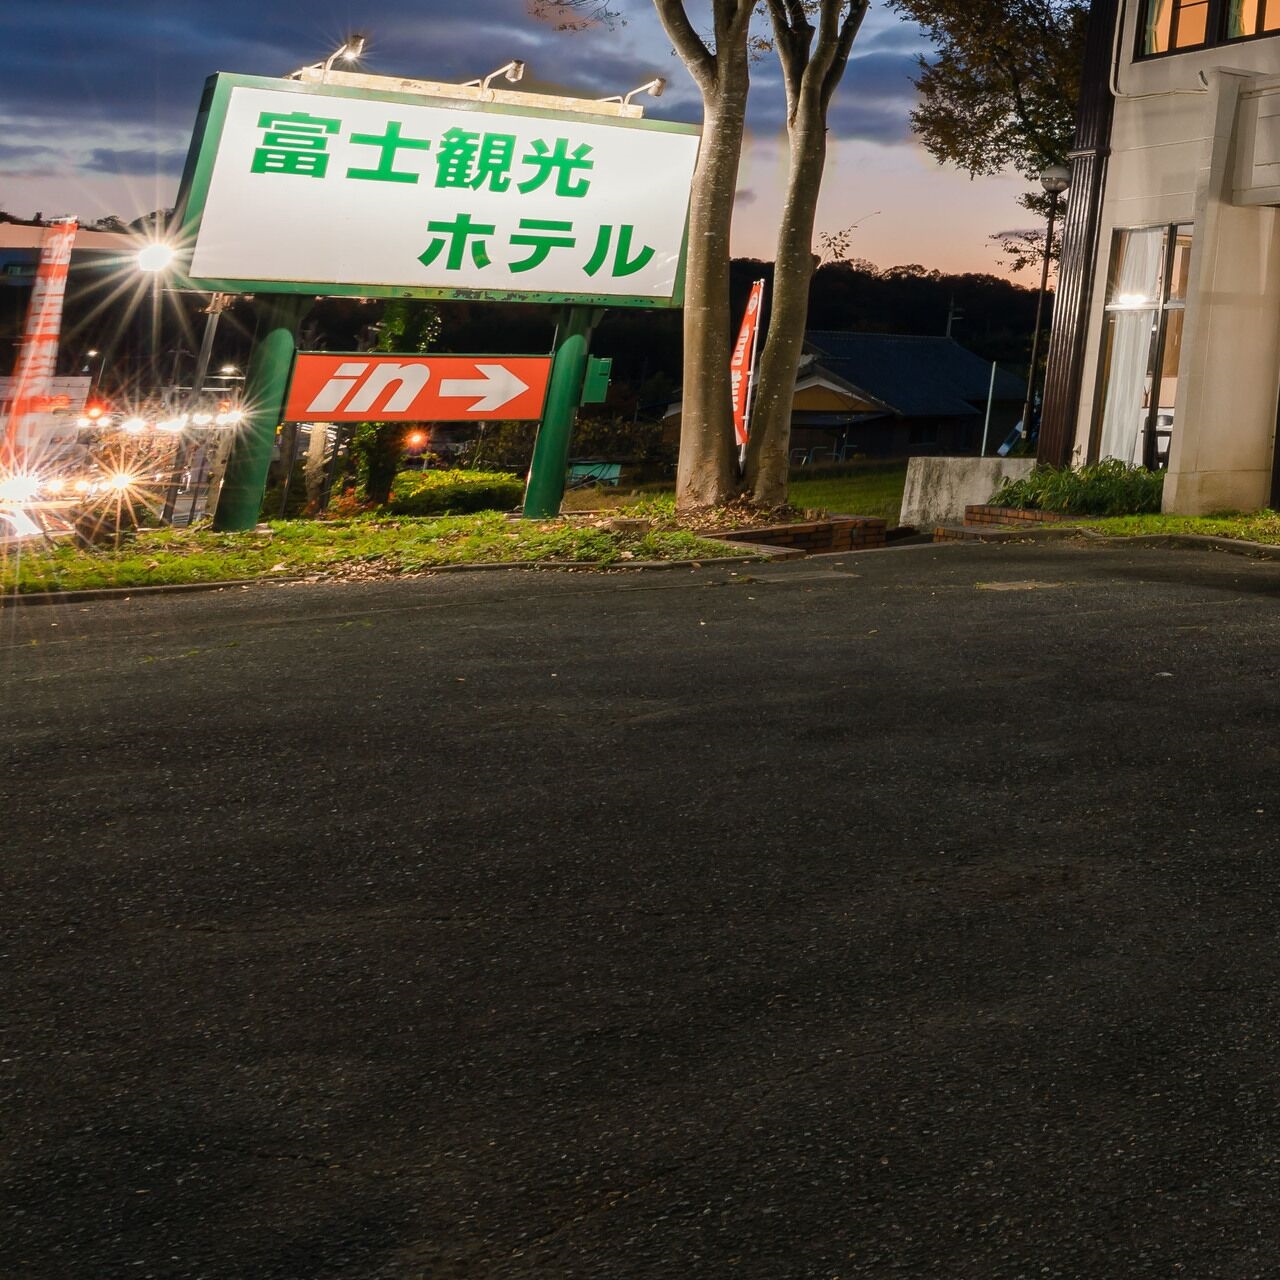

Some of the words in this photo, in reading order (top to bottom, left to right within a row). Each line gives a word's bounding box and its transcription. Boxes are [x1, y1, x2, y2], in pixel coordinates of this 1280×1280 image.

[251, 111, 594, 199] 富士観光
[418, 213, 655, 277] ホテル
[306, 363, 431, 412] in
